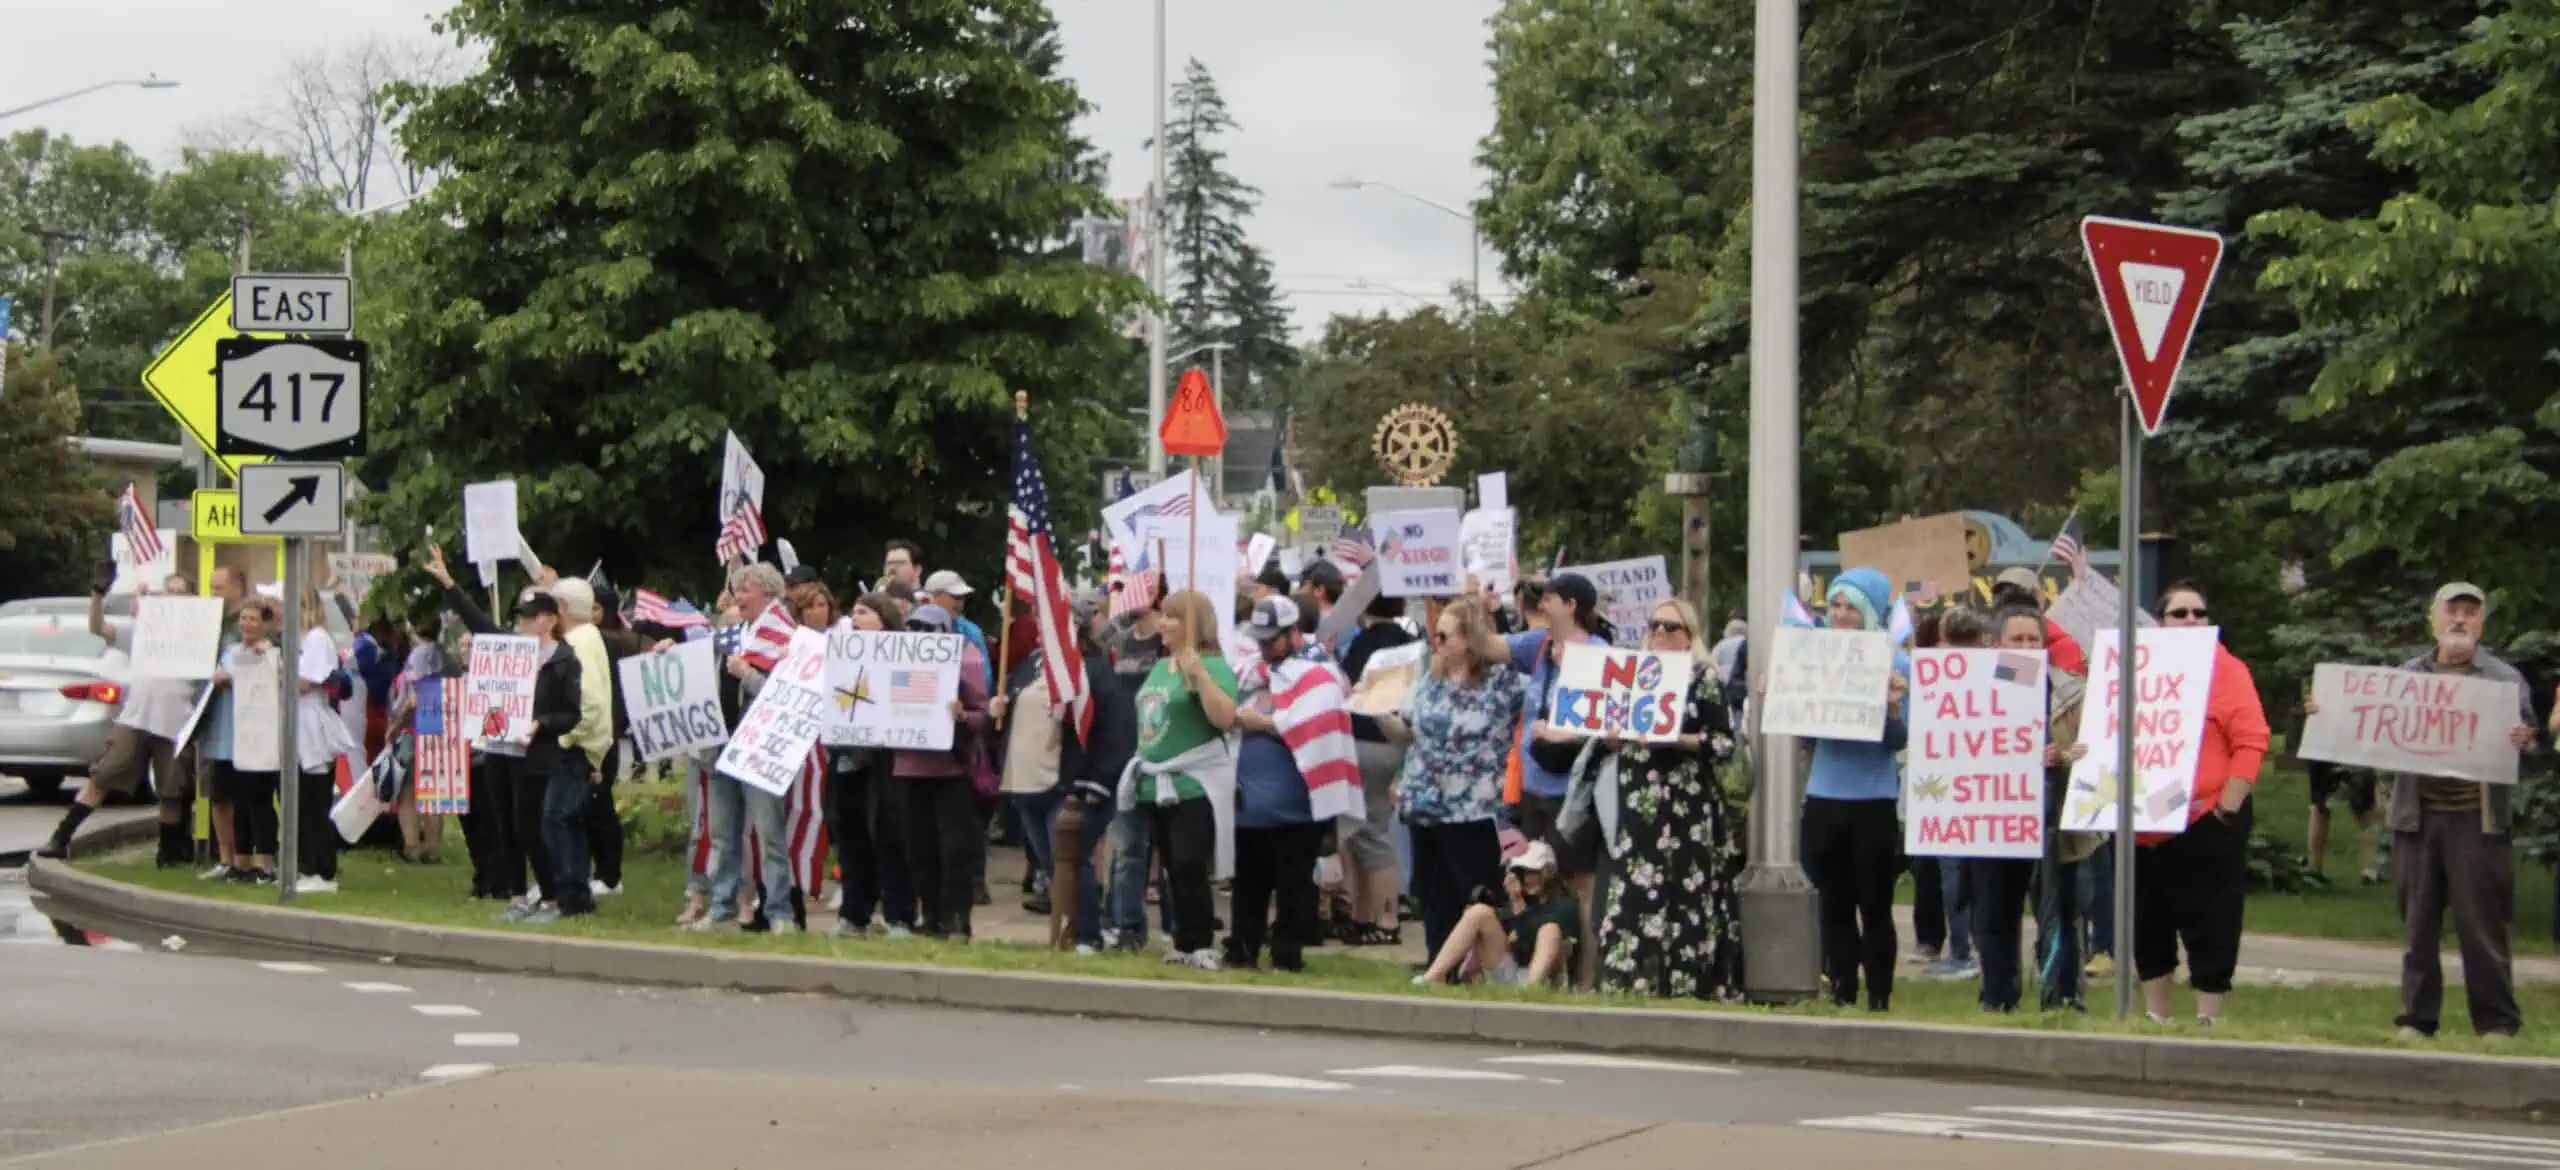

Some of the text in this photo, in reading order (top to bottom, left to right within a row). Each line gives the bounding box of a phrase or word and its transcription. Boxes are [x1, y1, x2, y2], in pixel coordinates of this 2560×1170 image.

[252, 285, 333, 322] EAST
[2135, 279, 2172, 305] YIELD
[237, 371, 346, 424] 417
[1182, 386, 1206, 412] 86
[207, 504, 236, 527] AH
[1402, 523, 1425, 538] NO
[1401, 547, 1449, 565] KINGS
[1596, 566, 1657, 585] STAND
[475, 639, 493, 652] YOU
[826, 632, 961, 664] NO KINGS!
[470, 651, 533, 678] HATRED
[640, 651, 686, 708] NO
[1602, 655, 1661, 691] NO
[1916, 652, 1968, 687] DO
[476, 679, 518, 693] WITHOUT
[2105, 672, 2185, 709] FUX
[2342, 668, 2461, 706] DETAIN
[465, 692, 490, 715] RED
[501, 692, 532, 720] HAT
[1555, 687, 1676, 735] KINGS
[1923, 688, 2007, 720] "ALL
[636, 698, 721, 755] KINGS
[829, 724, 929, 745] SINCE 1776
[1925, 717, 2043, 760] LIVES"
[2104, 708, 2182, 740] KNG
[2349, 702, 2480, 756] TRUMP!
[758, 731, 792, 758] ICE
[1951, 772, 2037, 804] STILL
[1917, 813, 2042, 845] MATTER
